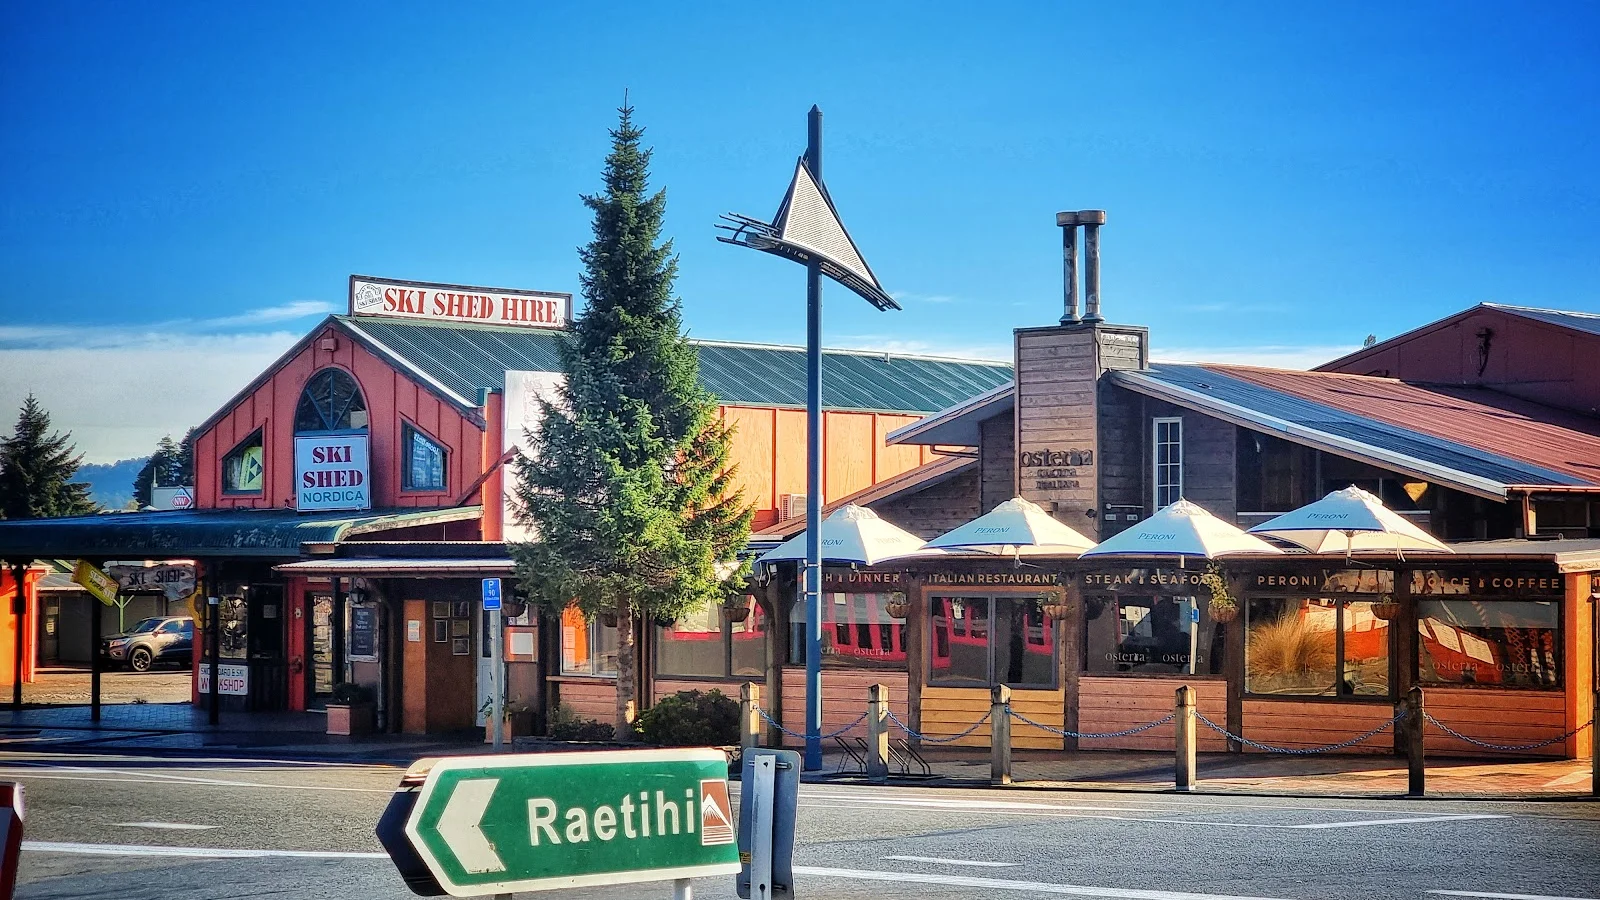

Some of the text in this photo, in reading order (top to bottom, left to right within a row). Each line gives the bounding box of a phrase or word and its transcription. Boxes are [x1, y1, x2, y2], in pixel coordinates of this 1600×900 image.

[383, 287, 427, 315] SKI
[433, 292, 494, 320] SHED
[501, 297, 557, 324] HIRE
[312, 446, 352, 464] SKI
[303, 470, 364, 489] SHED
[303, 491, 365, 503] NORDICA
[974, 527, 1011, 535] PERONI
[1138, 532, 1176, 541] PERONI
[821, 539, 844, 547] RONI
[488, 580, 495, 590] P
[849, 574, 901, 585] DINNER
[928, 573, 1058, 585] ITALIAN RESTAURANT
[1085, 574, 1132, 586] STEAK
[1257, 575, 1318, 586] PERONI
[1491, 577, 1559, 589] COFFEE
[1105, 652, 1146, 662] osteria
[201, 678, 245, 692] WKSHOP
[527, 788, 694, 847] Raetihi
